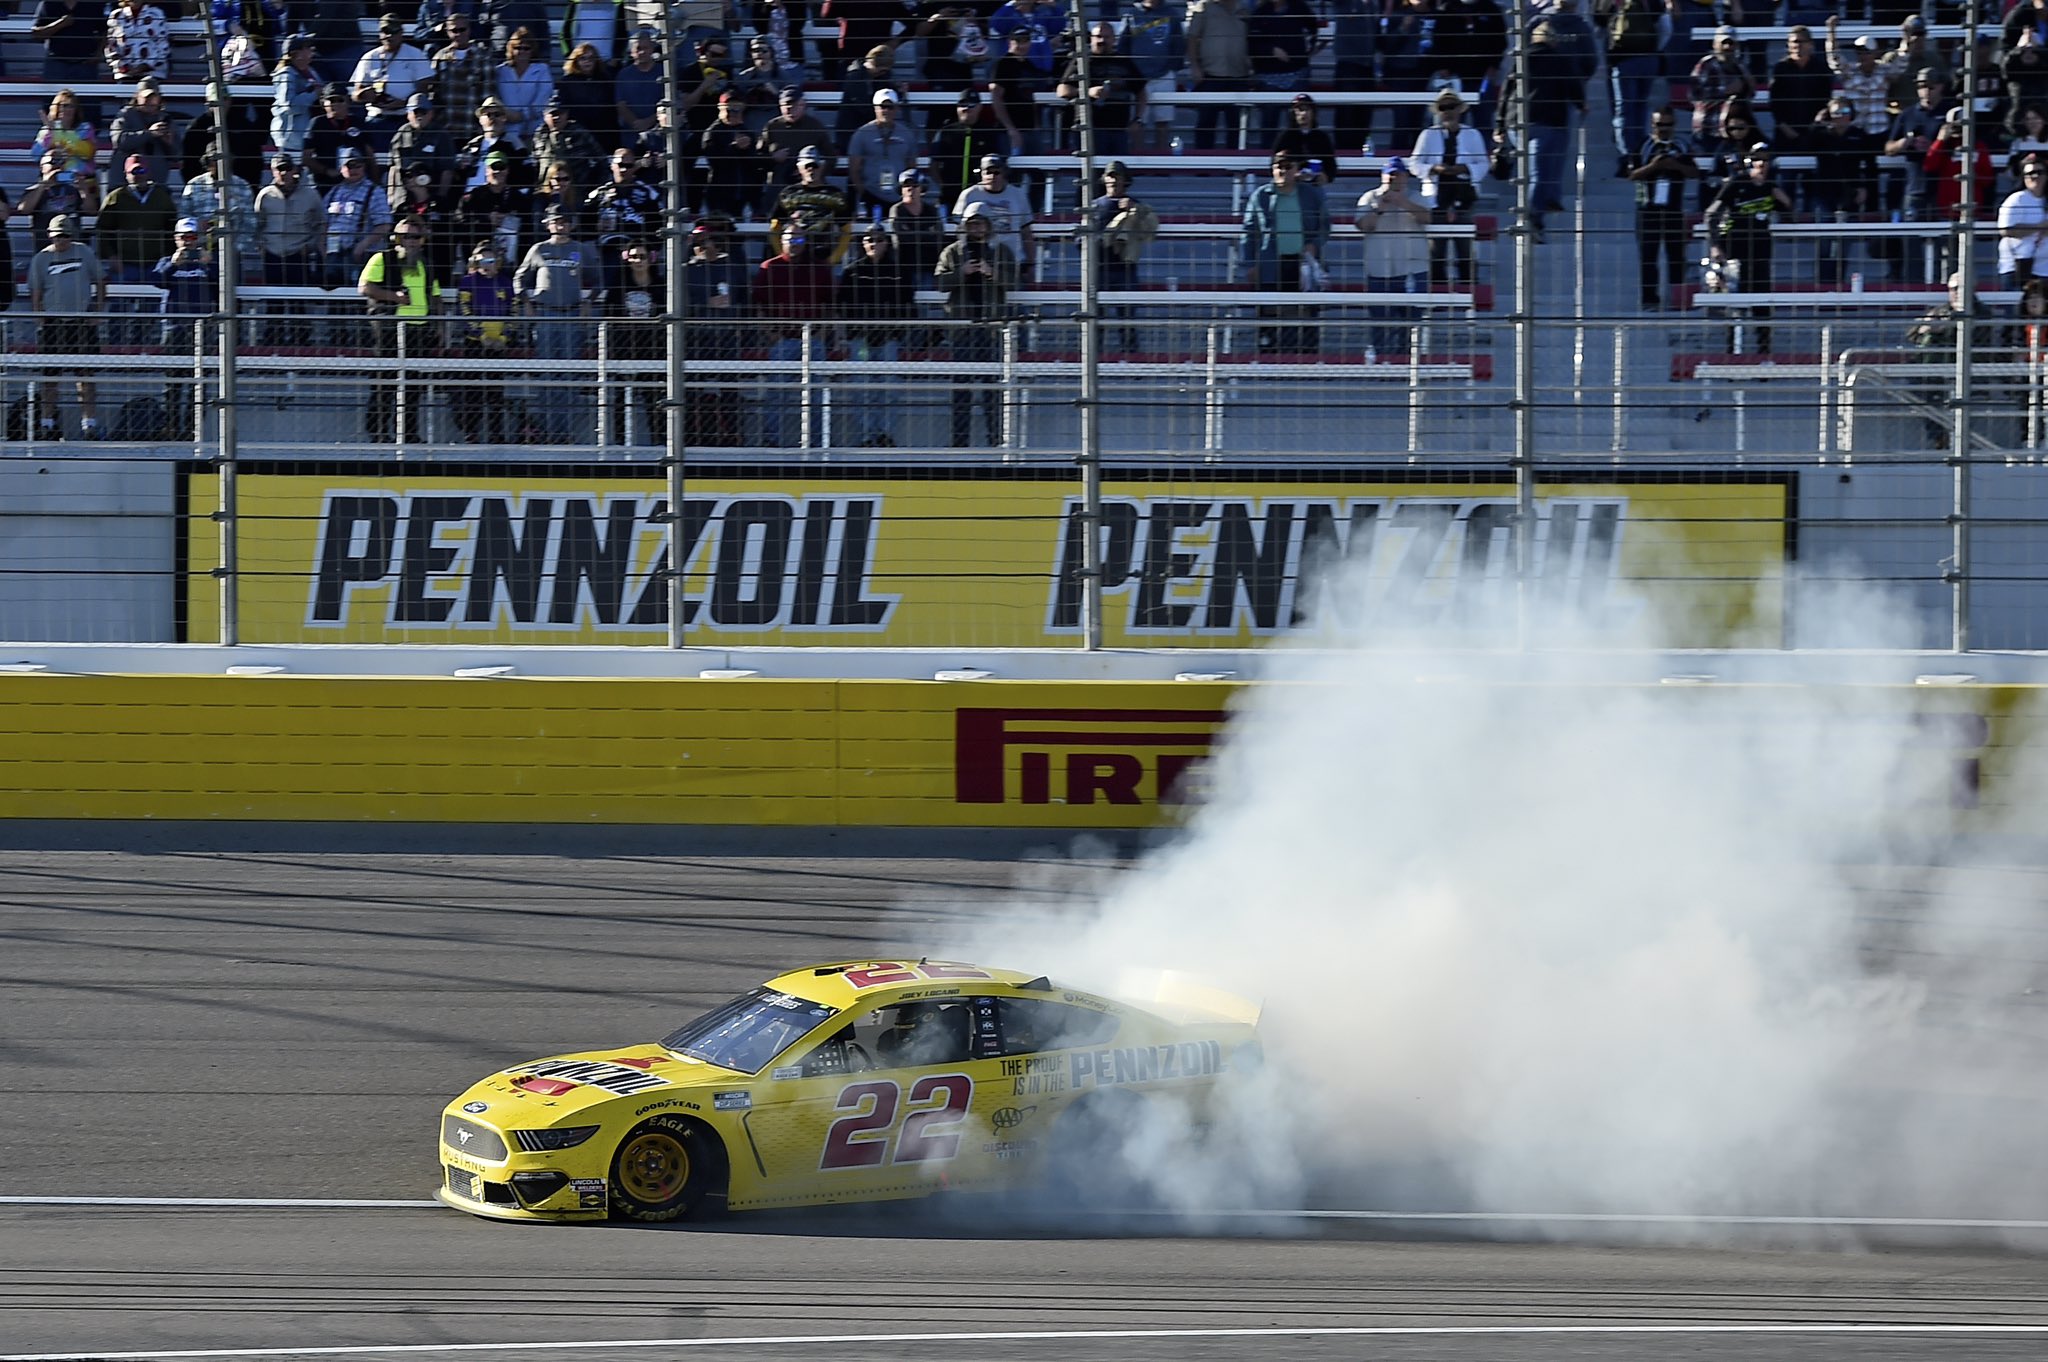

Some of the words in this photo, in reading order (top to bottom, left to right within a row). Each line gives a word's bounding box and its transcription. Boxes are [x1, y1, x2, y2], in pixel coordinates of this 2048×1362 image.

[304, 489, 903, 633] PENNZOIL
[1043, 495, 1648, 636] PENNZOIL
[898, 991, 923, 1000] JOEY
[1000, 1060, 1022, 1076] THE
[1070, 1040, 1228, 1089] PENNZOIL
[1013, 1077, 1025, 1096] IS
[1028, 1075, 1041, 1095] IN
[1044, 1073, 1065, 1093] THE
[635, 1098, 701, 1117] GOODYEAR
[994, 1108, 1021, 1127] AAA
[648, 1116, 694, 1138] EAGLE
[818, 1072, 975, 1173] 22
[443, 1148, 486, 1173] MUSTANG
